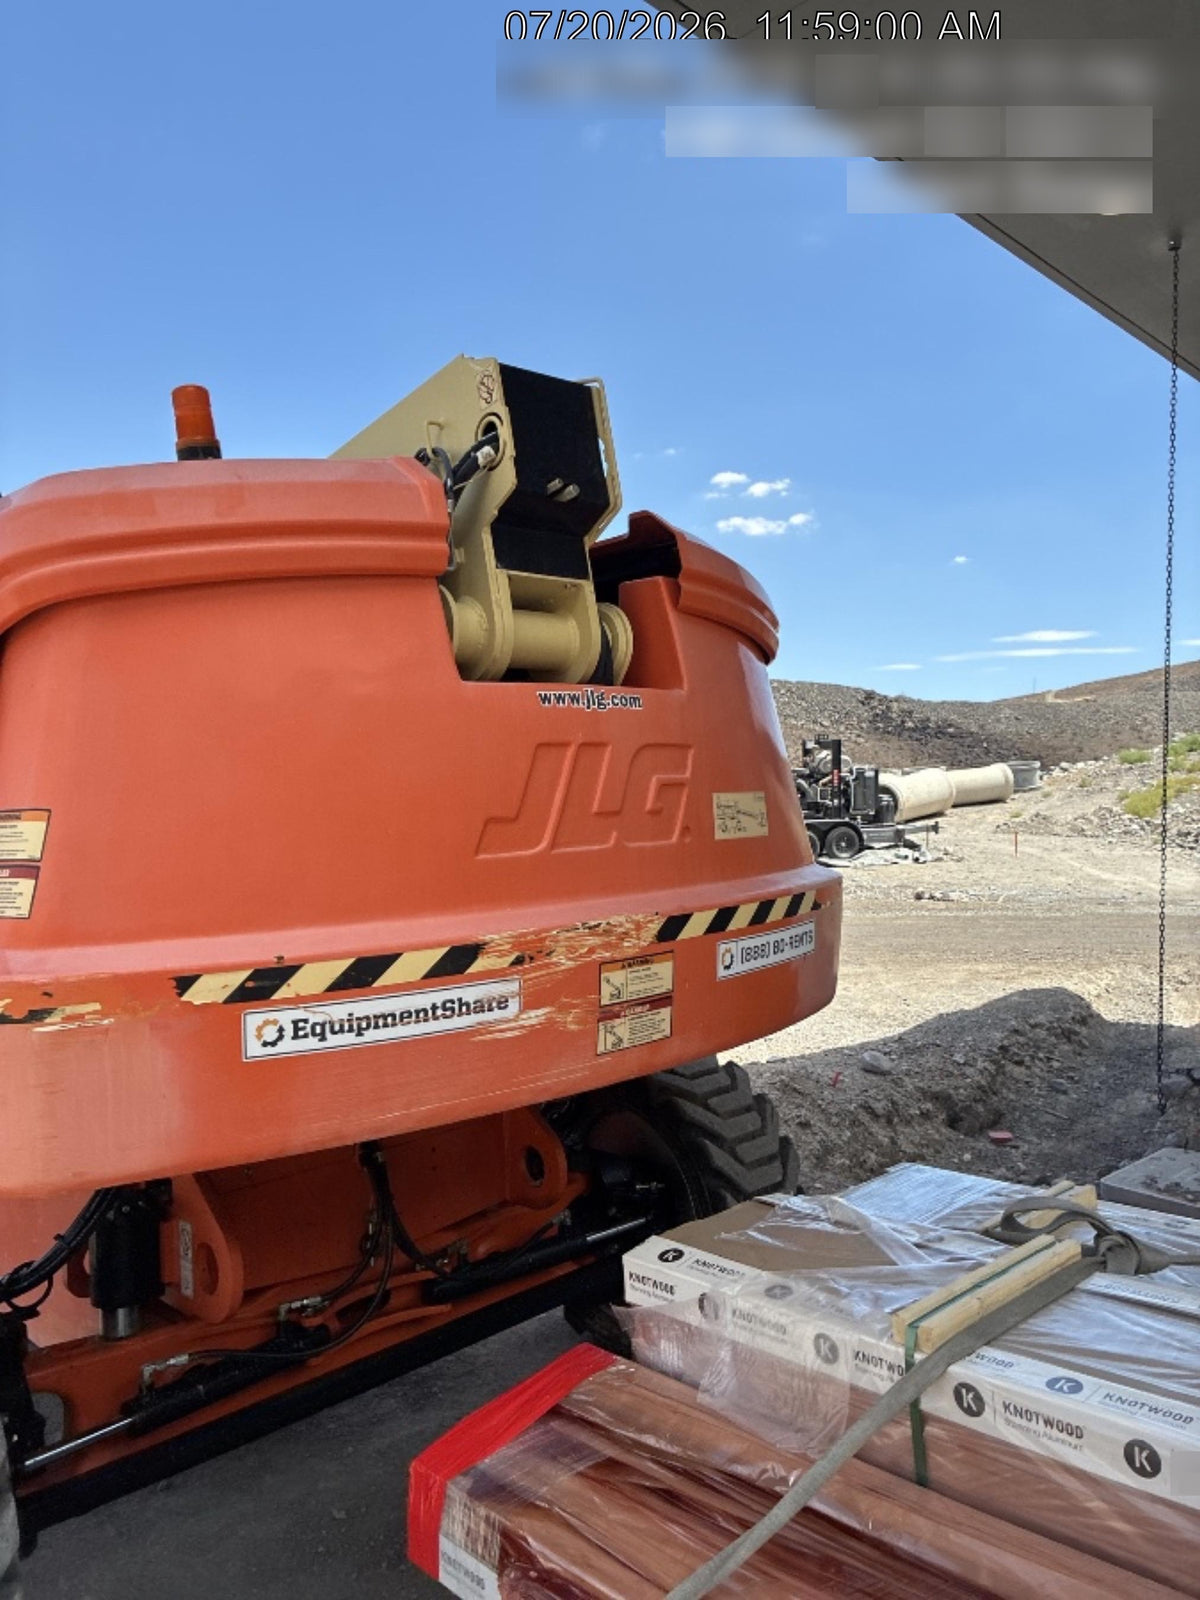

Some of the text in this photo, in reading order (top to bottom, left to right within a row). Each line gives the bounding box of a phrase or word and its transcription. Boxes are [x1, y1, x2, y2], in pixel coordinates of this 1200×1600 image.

[537, 688, 643, 711] www.jlg.com
[475, 741, 695, 860] JLG
[291, 996, 510, 1042] EquipmentShare
[854, 1349, 905, 1377] KNOTWO
[1002, 1400, 1084, 1440] KNOTWOOD
[1103, 1392, 1195, 1425] KNOTWOOD
